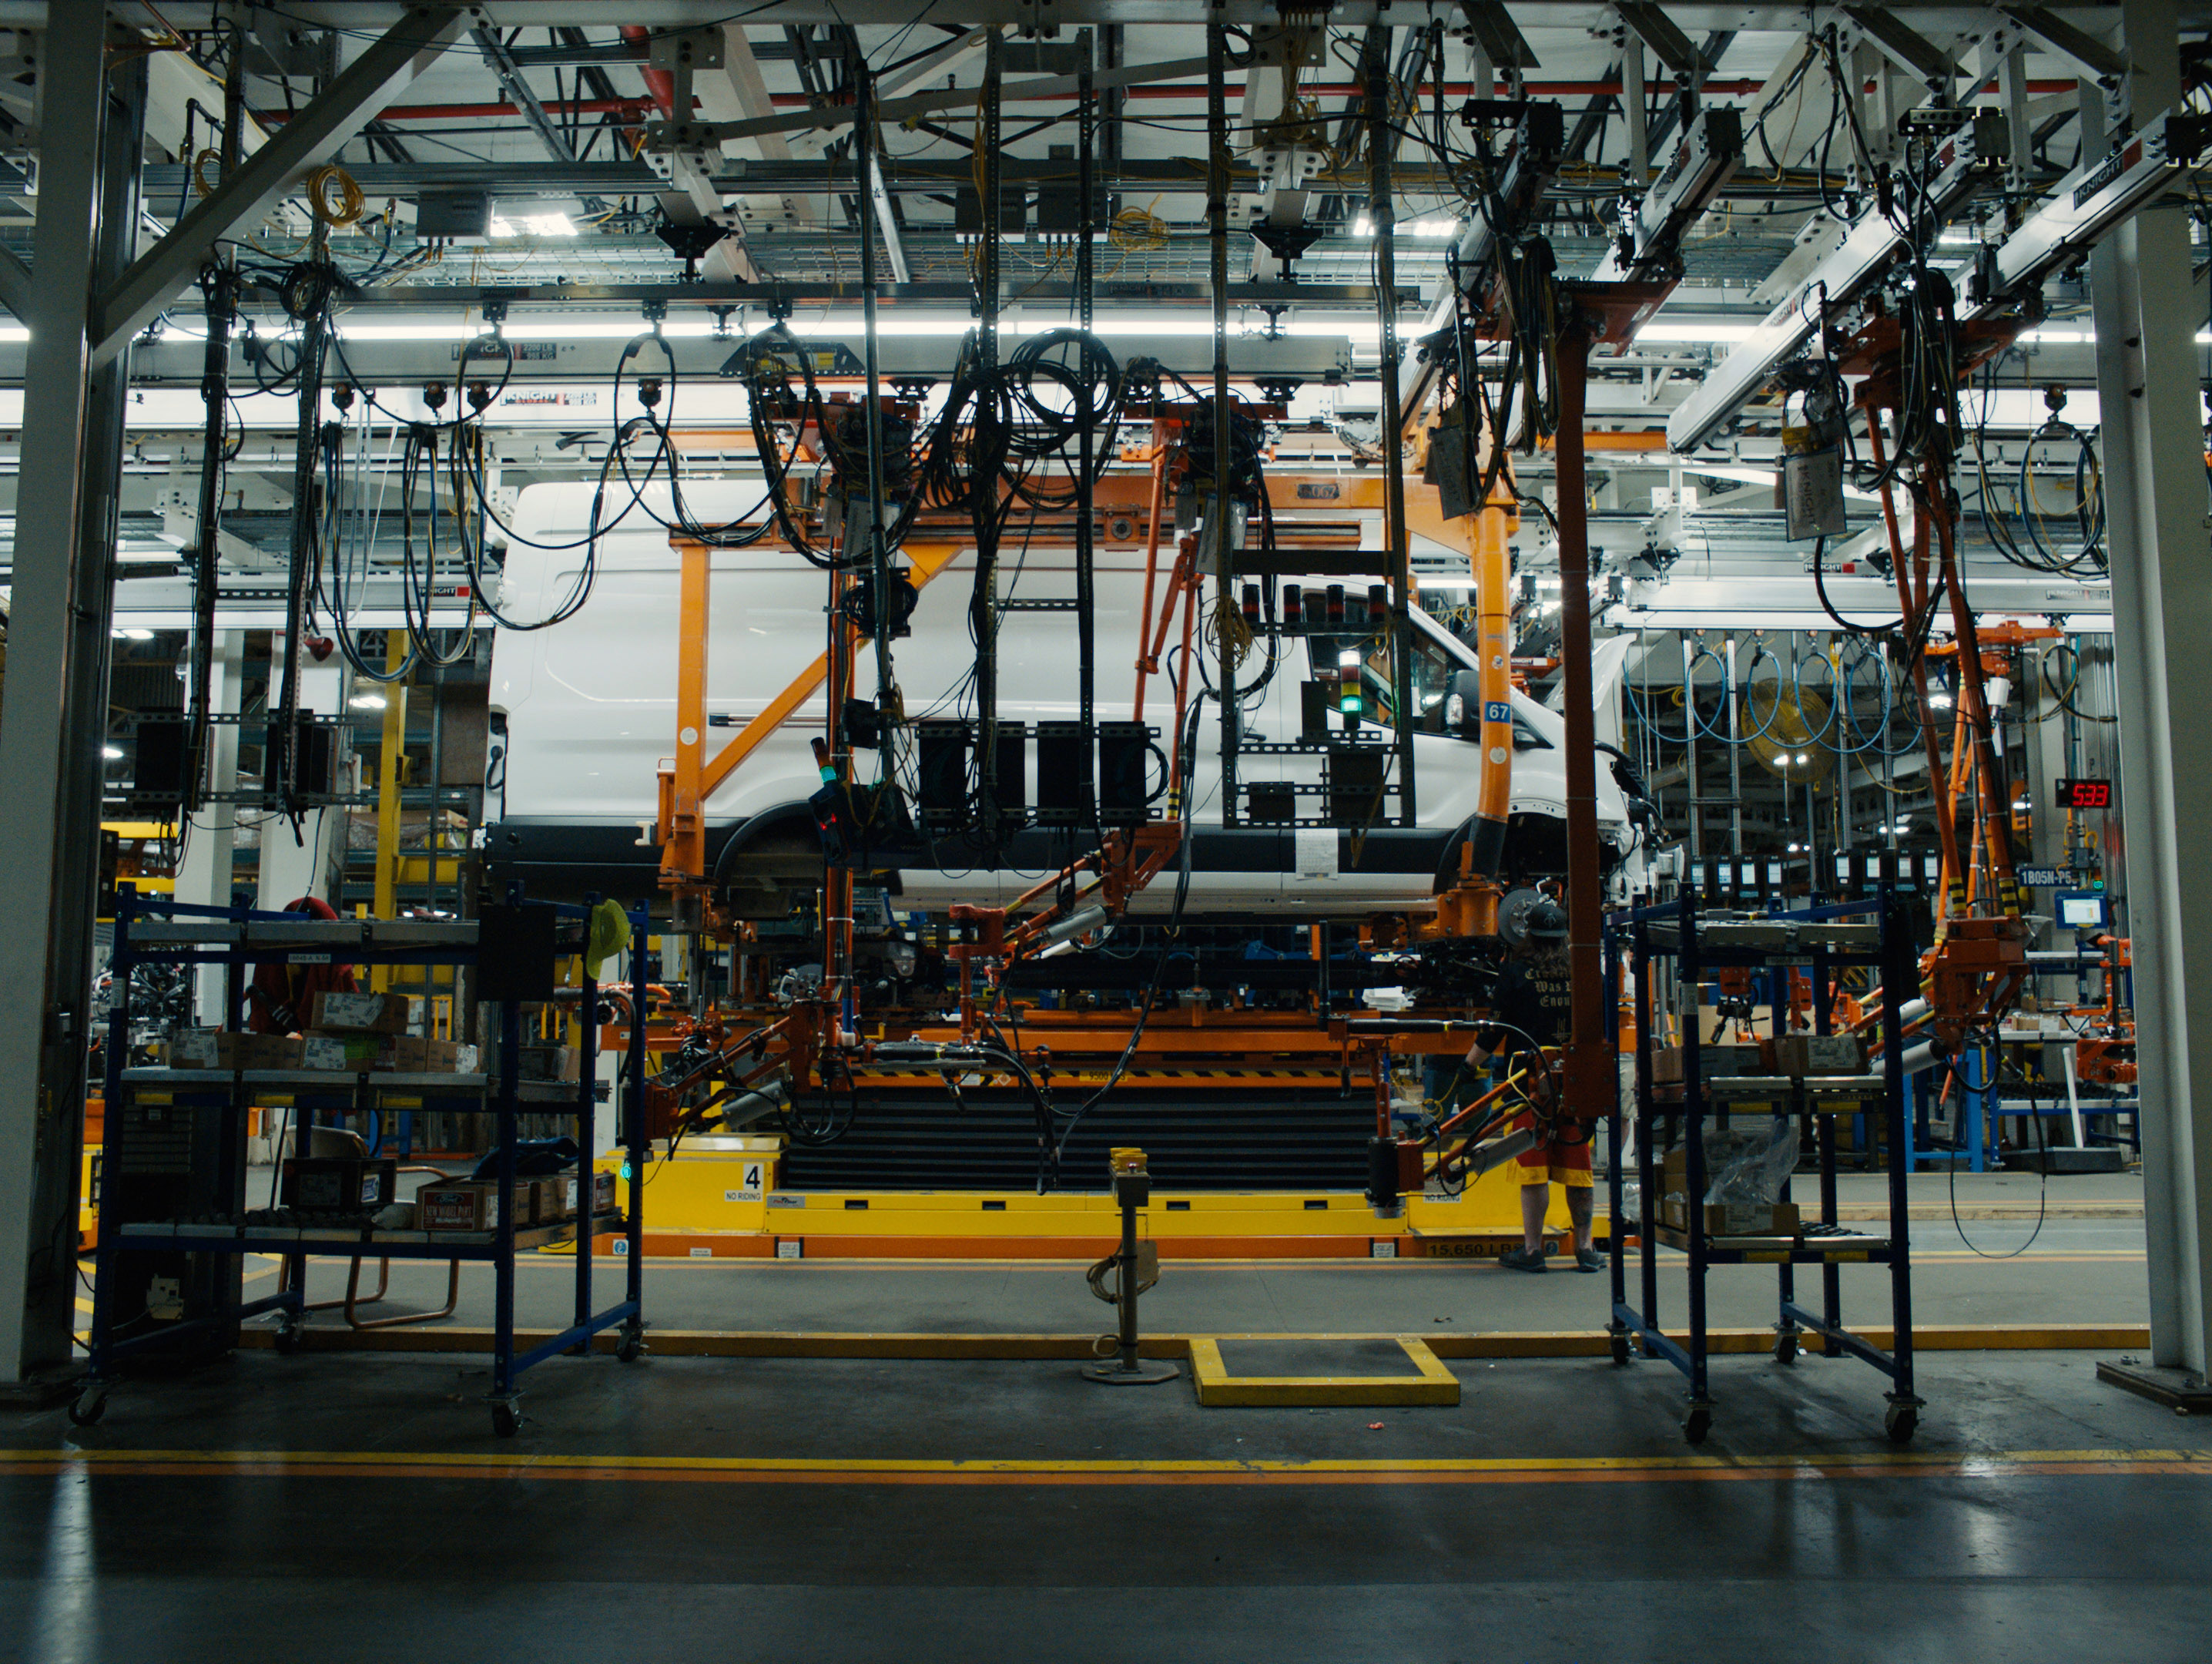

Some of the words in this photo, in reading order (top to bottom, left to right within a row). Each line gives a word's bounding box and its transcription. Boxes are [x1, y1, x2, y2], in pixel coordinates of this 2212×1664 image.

[2079, 157, 2123, 200] KNIGHT
[507, 392, 556, 401] KNIGHT
[1489, 704, 1509, 720] 67
[2073, 783, 2110, 807] 533
[1534, 981, 1561, 993] Was
[1540, 995, 1570, 1007] Enou
[1089, 1072, 1108, 1080] 9500
[746, 1165, 760, 1189] 4
[726, 1192, 736, 1200] NO
[738, 1192, 761, 1201] RIDING
